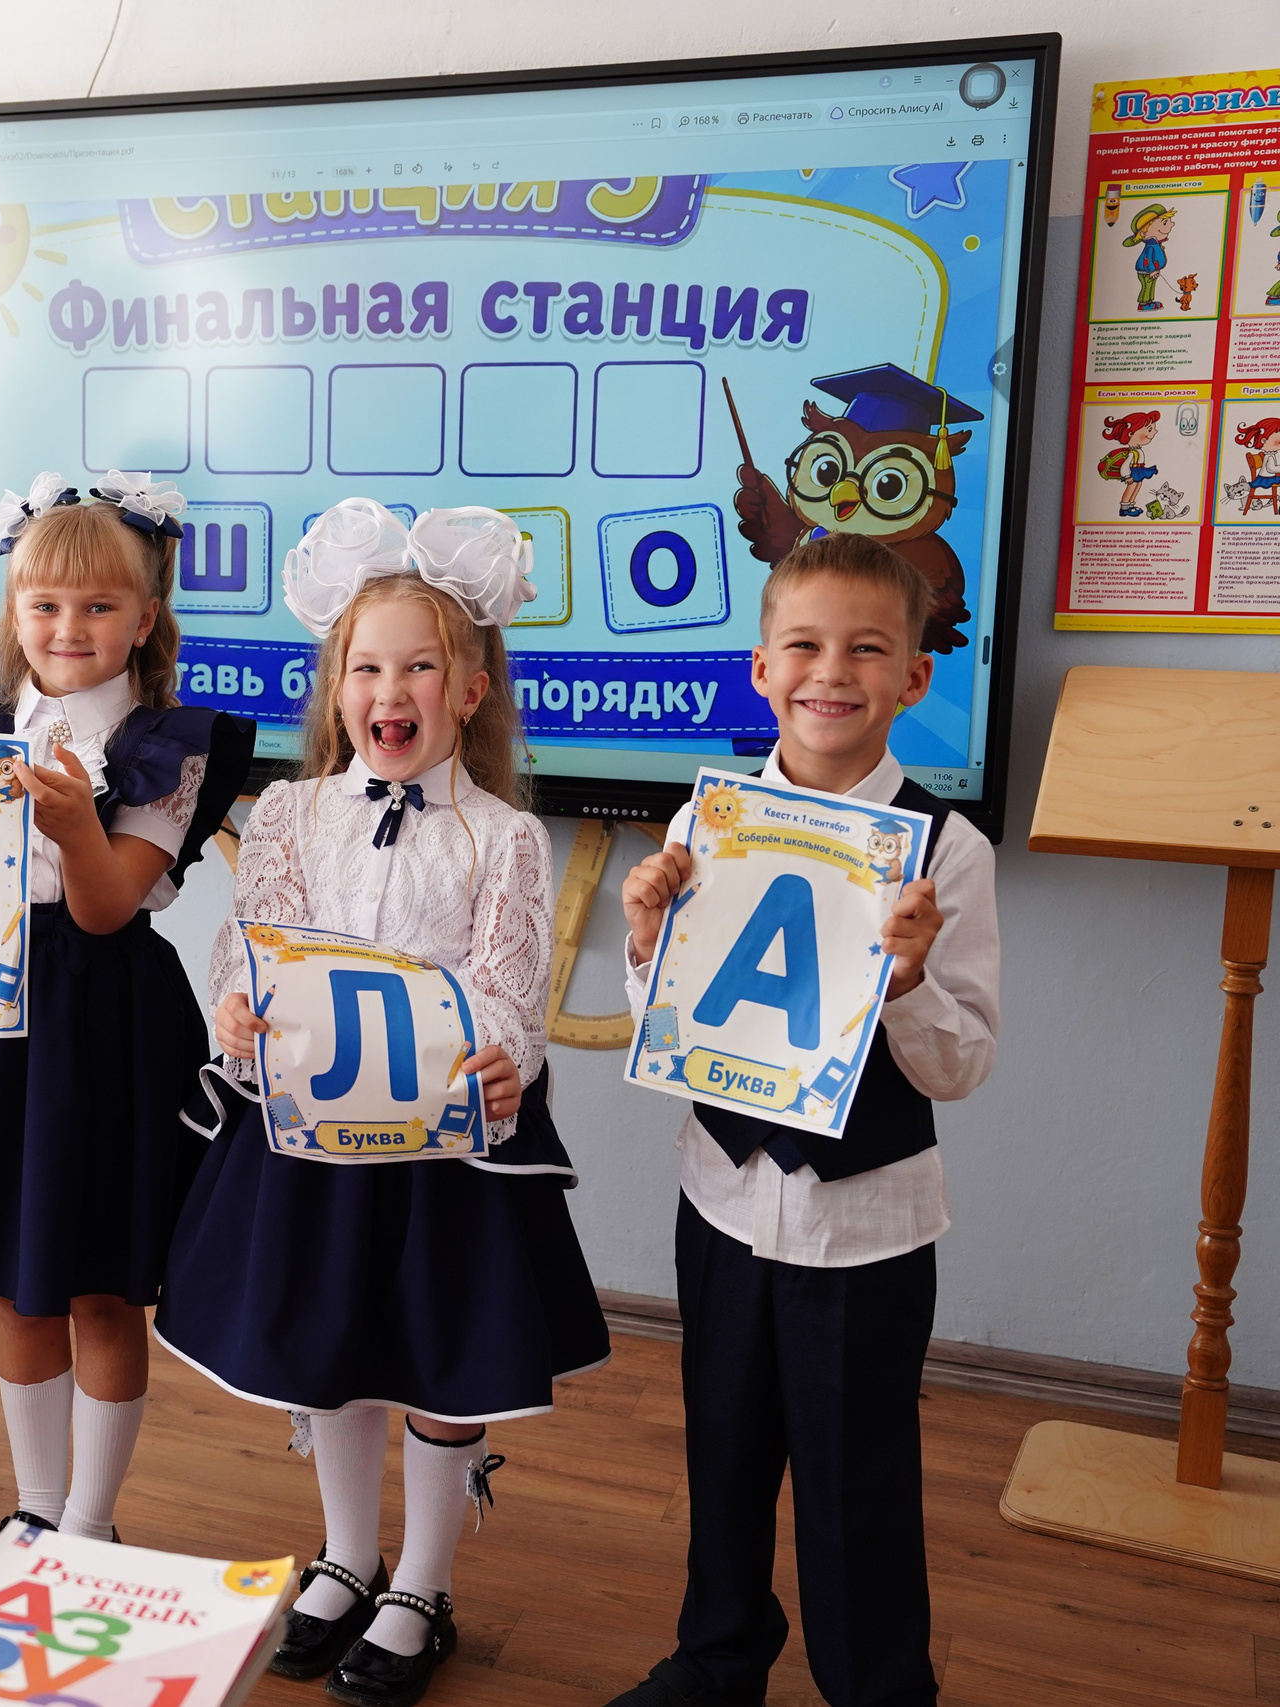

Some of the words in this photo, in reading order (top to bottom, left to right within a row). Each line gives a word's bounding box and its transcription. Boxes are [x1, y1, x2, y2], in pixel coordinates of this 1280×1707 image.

[752, 110, 813, 123] Распечатать
[848, 105, 896, 118] Спросить
[898, 102, 931, 116] Алису
[1123, 134, 1178, 144] Правильная
[1182, 131, 1216, 140] осанка
[1218, 128, 1262, 137] помогает
[1096, 146, 1134, 156] придаёт
[1136, 142, 1189, 153] стройность
[1200, 140, 1239, 150] красоту
[1241, 137, 1276, 148] фигуре
[1143, 154, 1183, 162] Человек
[1194, 149, 1251, 160] правильной
[335, 168, 354, 176] 168%
[1132, 164, 1182, 174] «сидячей»
[1184, 162, 1222, 172] работы,
[1224, 160, 1259, 170] потому
[1260, 158, 1277, 166] что
[1134, 182, 1182, 191] положении
[48, 278, 450, 351] Финальная
[480, 279, 810, 351] станция
[180, 523, 248, 592] Ш
[629, 530, 697, 608] О
[516, 676, 719, 724] порядку
[259, 740, 282, 749] Поиск
[933, 773, 953, 781] 11:06
[923, 783, 953, 792] 09.2026
[764, 806, 790, 820] Квест
[802, 814, 806, 824] 1
[809, 817, 850, 834] сентября
[737, 832, 782, 850] Соберём
[784, 838, 831, 856] школьное
[833, 846, 865, 869] солнце
[692, 874, 820, 1051] А
[310, 969, 419, 1102] Л
[706, 1060, 778, 1098] Буква
[338, 1128, 406, 1150] Буква
[27, 1555, 183, 1603] Русский
